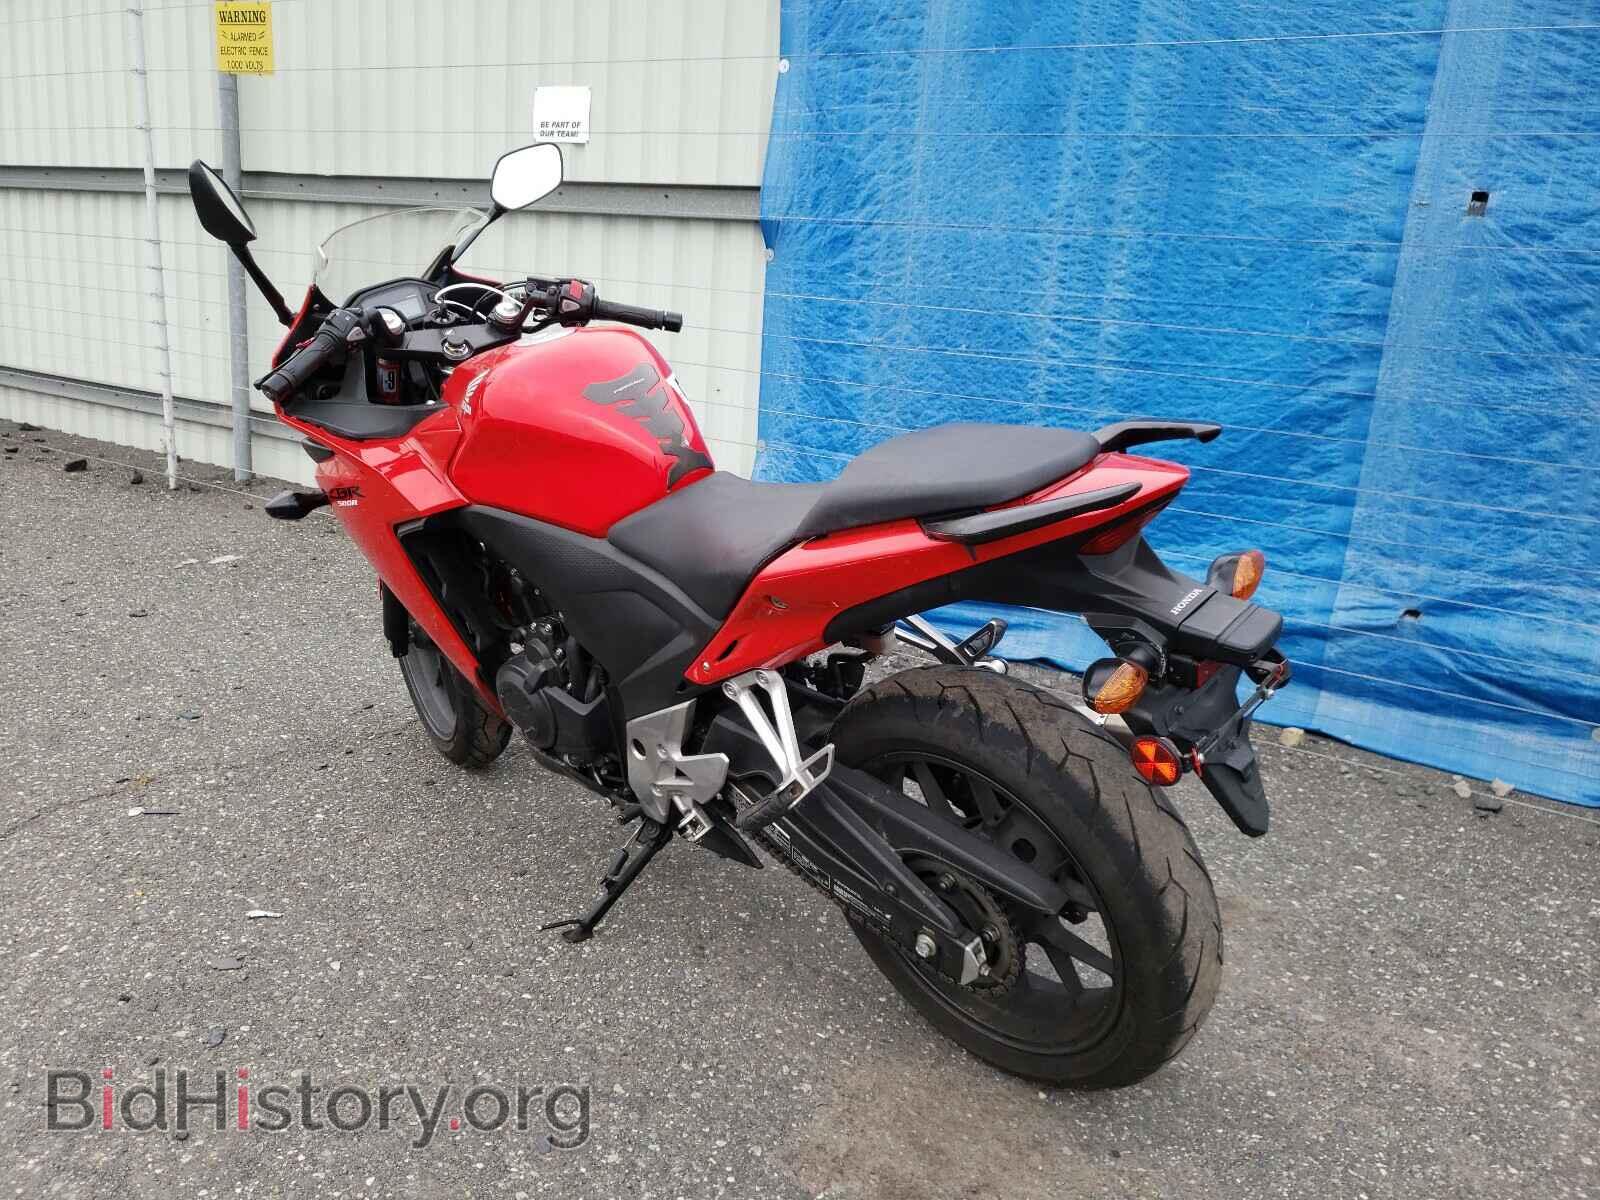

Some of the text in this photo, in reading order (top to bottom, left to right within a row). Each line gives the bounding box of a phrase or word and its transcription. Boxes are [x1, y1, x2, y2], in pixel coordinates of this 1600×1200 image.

[219, 10, 266, 23] WARNING
[230, 32, 257, 41] ALARMED
[220, 46, 268, 56] ELECTRIC FENCE
[245, 60, 264, 70] VOLTS
[540, 121, 581, 129] BE PART OF
[540, 129, 554, 137] OUR
[1170, 588, 1203, 615] HONDA
